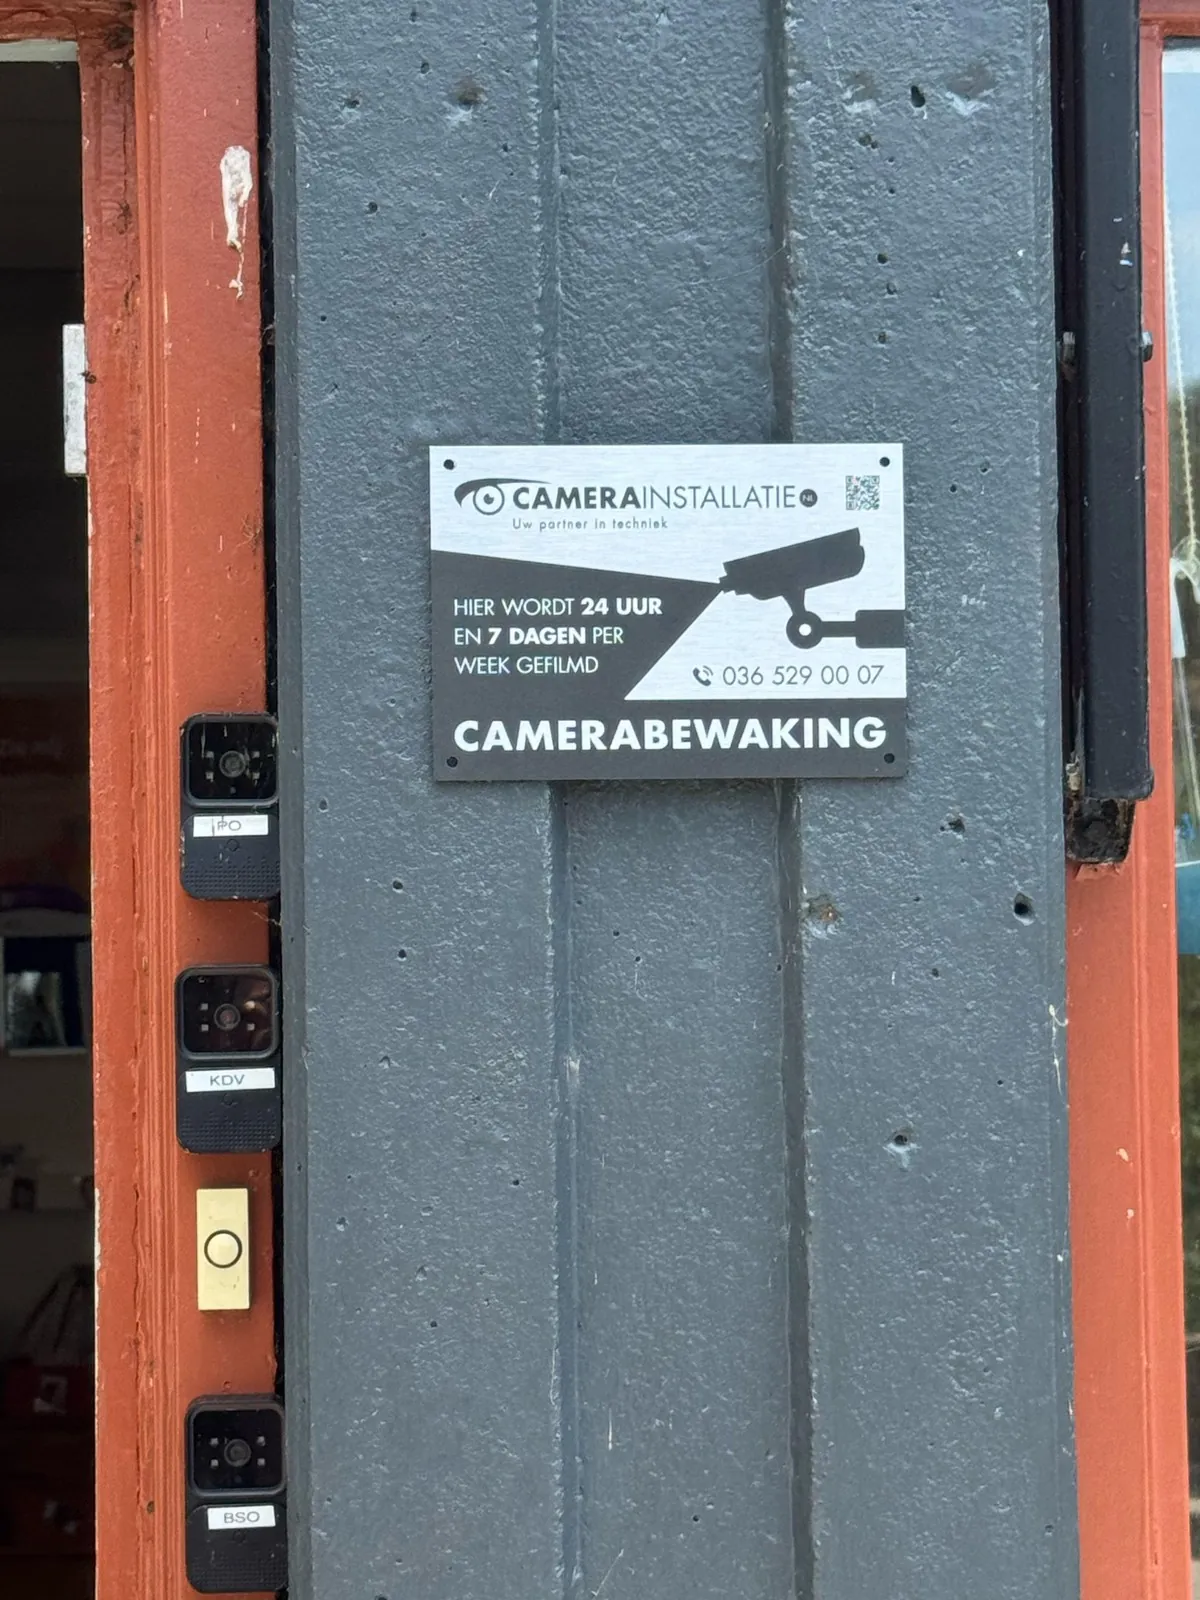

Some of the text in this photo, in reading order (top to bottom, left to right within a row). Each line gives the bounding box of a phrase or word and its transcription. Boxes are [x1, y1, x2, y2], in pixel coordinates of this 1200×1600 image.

[513, 485, 796, 510] CAMERAINSTALLATIE
[512, 517, 668, 532] Uw partner in techniek
[453, 597, 663, 619] HIER WORDT 24 UUR
[453, 627, 624, 646] EN 7 DAGEN PER
[453, 656, 599, 675] WEEK GEFILMD
[723, 665, 885, 686] 036 529 00 07
[453, 715, 887, 753] CAMERABEWAKING
[210, 1074, 245, 1086] KDV
[224, 1511, 260, 1524] BSO
